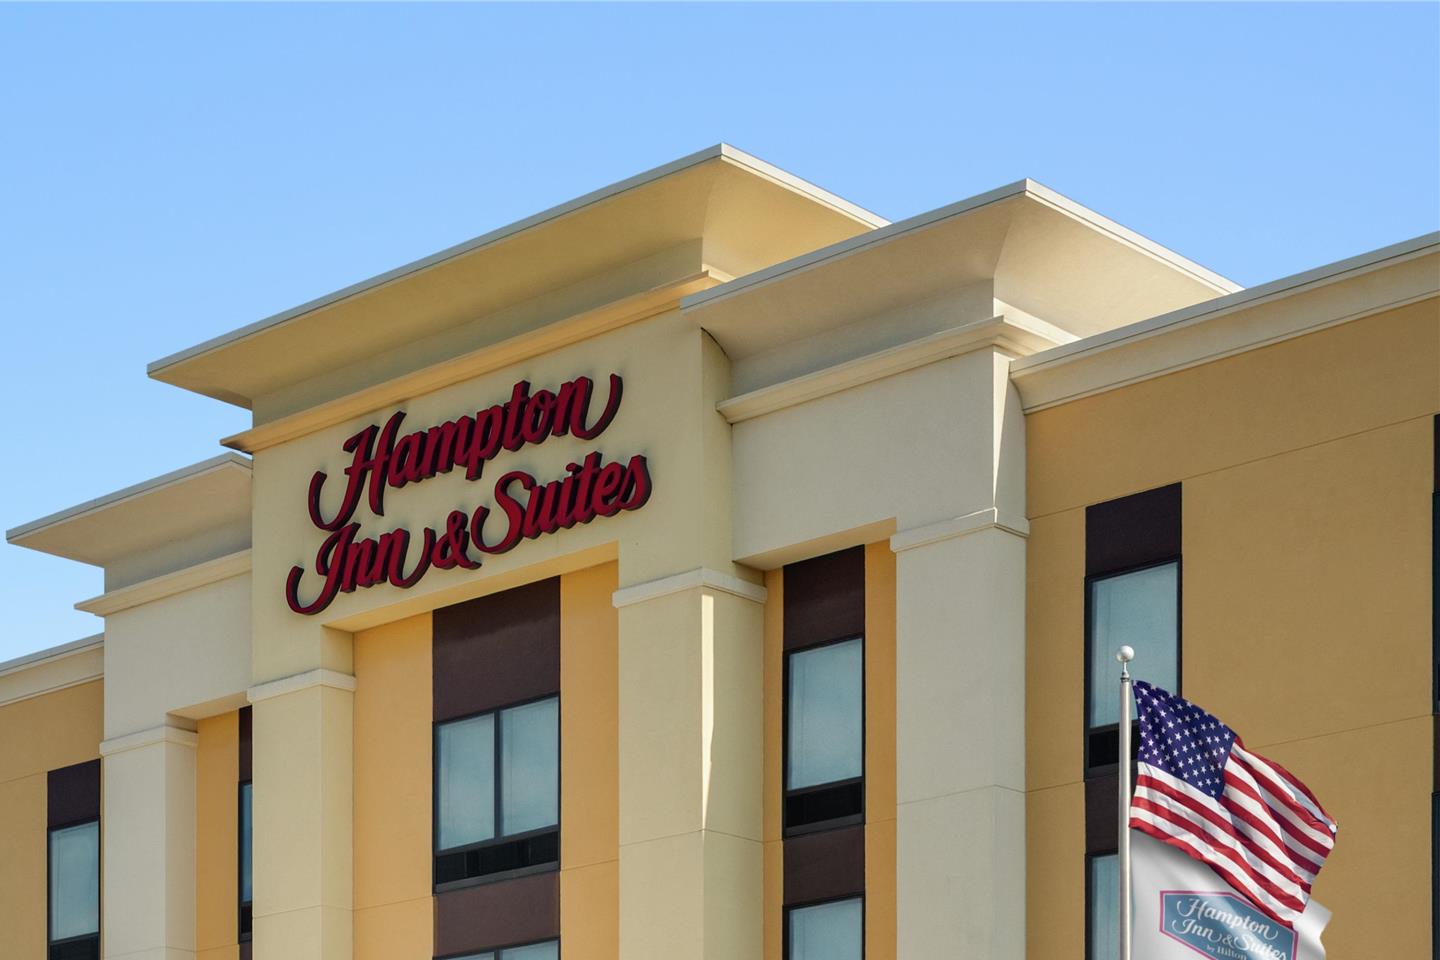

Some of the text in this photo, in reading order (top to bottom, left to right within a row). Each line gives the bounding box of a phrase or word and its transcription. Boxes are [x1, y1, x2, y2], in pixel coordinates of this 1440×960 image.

[308, 373, 623, 532] Hampton
[286, 451, 652, 616] Inn & Suites
[1171, 918, 1222, 943] Inn
[1222, 933, 1236, 949] &
[1176, 898, 1279, 940] Hampton
[1216, 946, 1248, 960] Hilton
